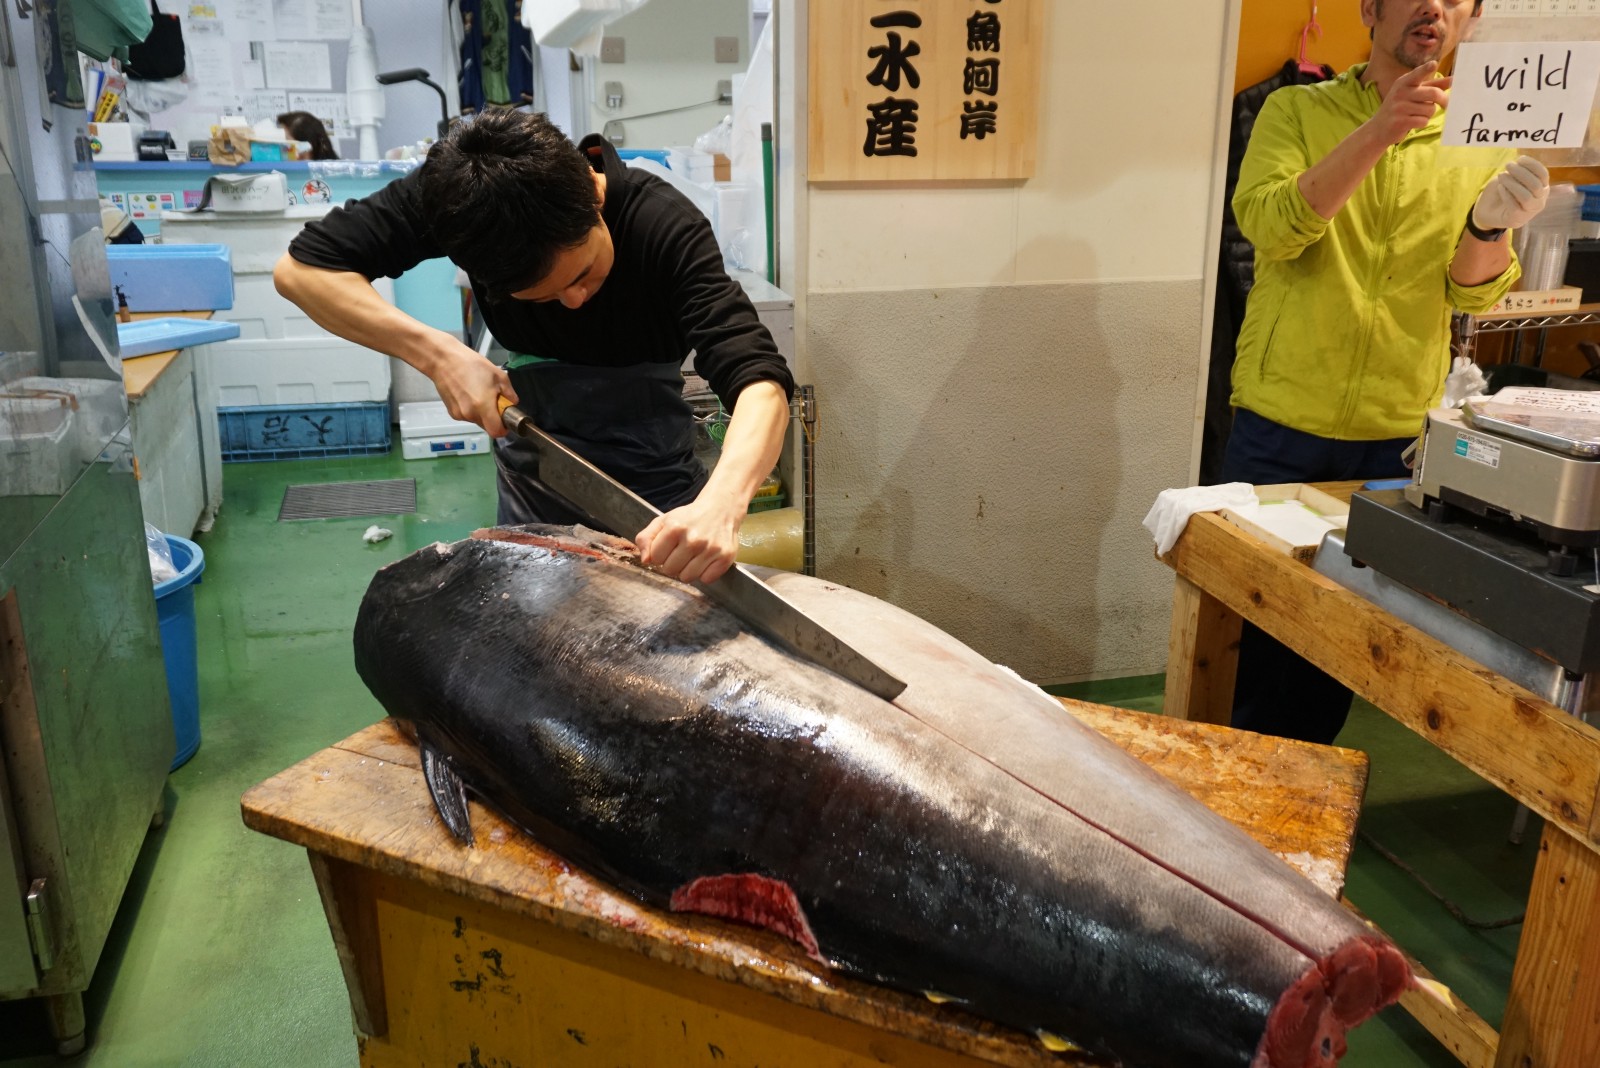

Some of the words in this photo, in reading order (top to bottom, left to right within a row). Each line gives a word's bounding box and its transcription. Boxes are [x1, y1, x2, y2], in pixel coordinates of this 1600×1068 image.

[862, 10, 922, 157] 一水産
[960, 0, 1001, 140] 魚河岸
[1485, 50, 1571, 90] wild
[1507, 102, 1531, 112] or
[1461, 112, 1563, 145] farmed
[1504, 296, 1533, 311] たらこ
